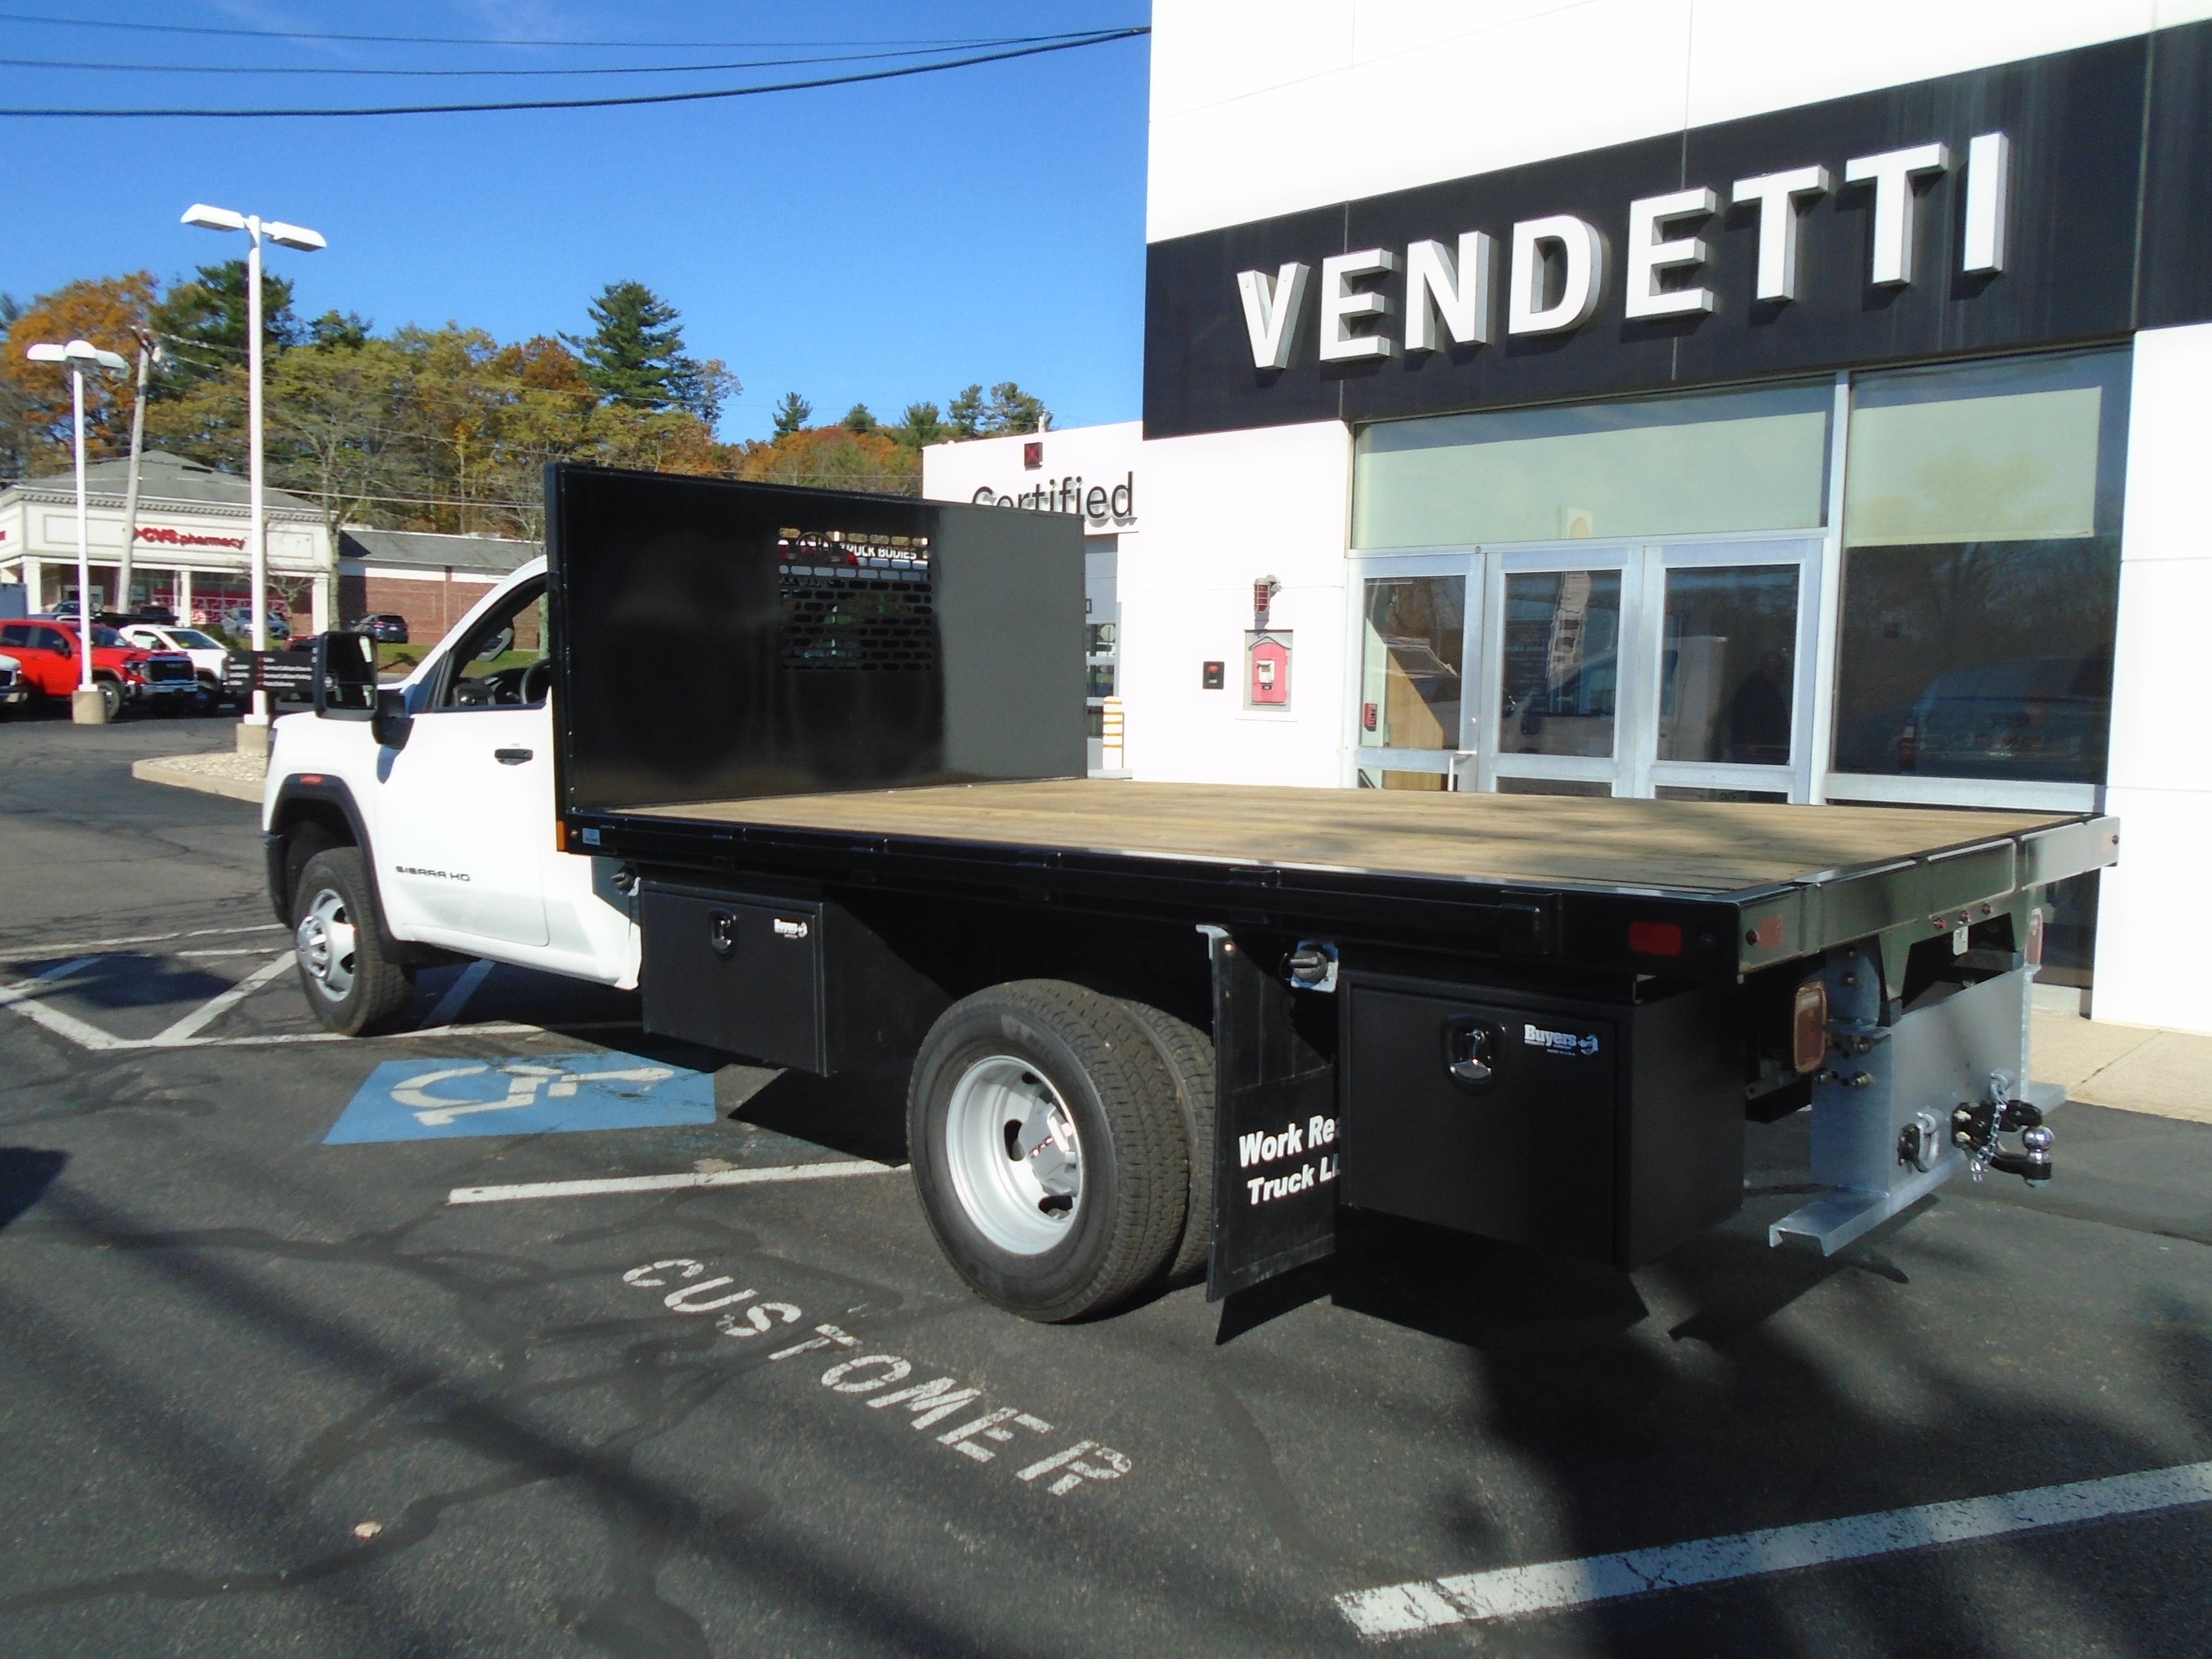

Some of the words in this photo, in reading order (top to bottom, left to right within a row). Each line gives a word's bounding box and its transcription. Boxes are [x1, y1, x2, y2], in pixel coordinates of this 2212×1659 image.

[1236, 131, 2009, 369] VENDETTI
[142, 528, 178, 544] CVS
[180, 532, 246, 551] pharmacy
[396, 866, 446, 878] SIERRA
[450, 873, 470, 882] HD
[1524, 1024, 1577, 1047] Buyers
[1239, 1123, 1302, 1167] Work
[1247, 1164, 1315, 1205] Truck
[623, 1258, 1132, 1496] CUSTOMER
